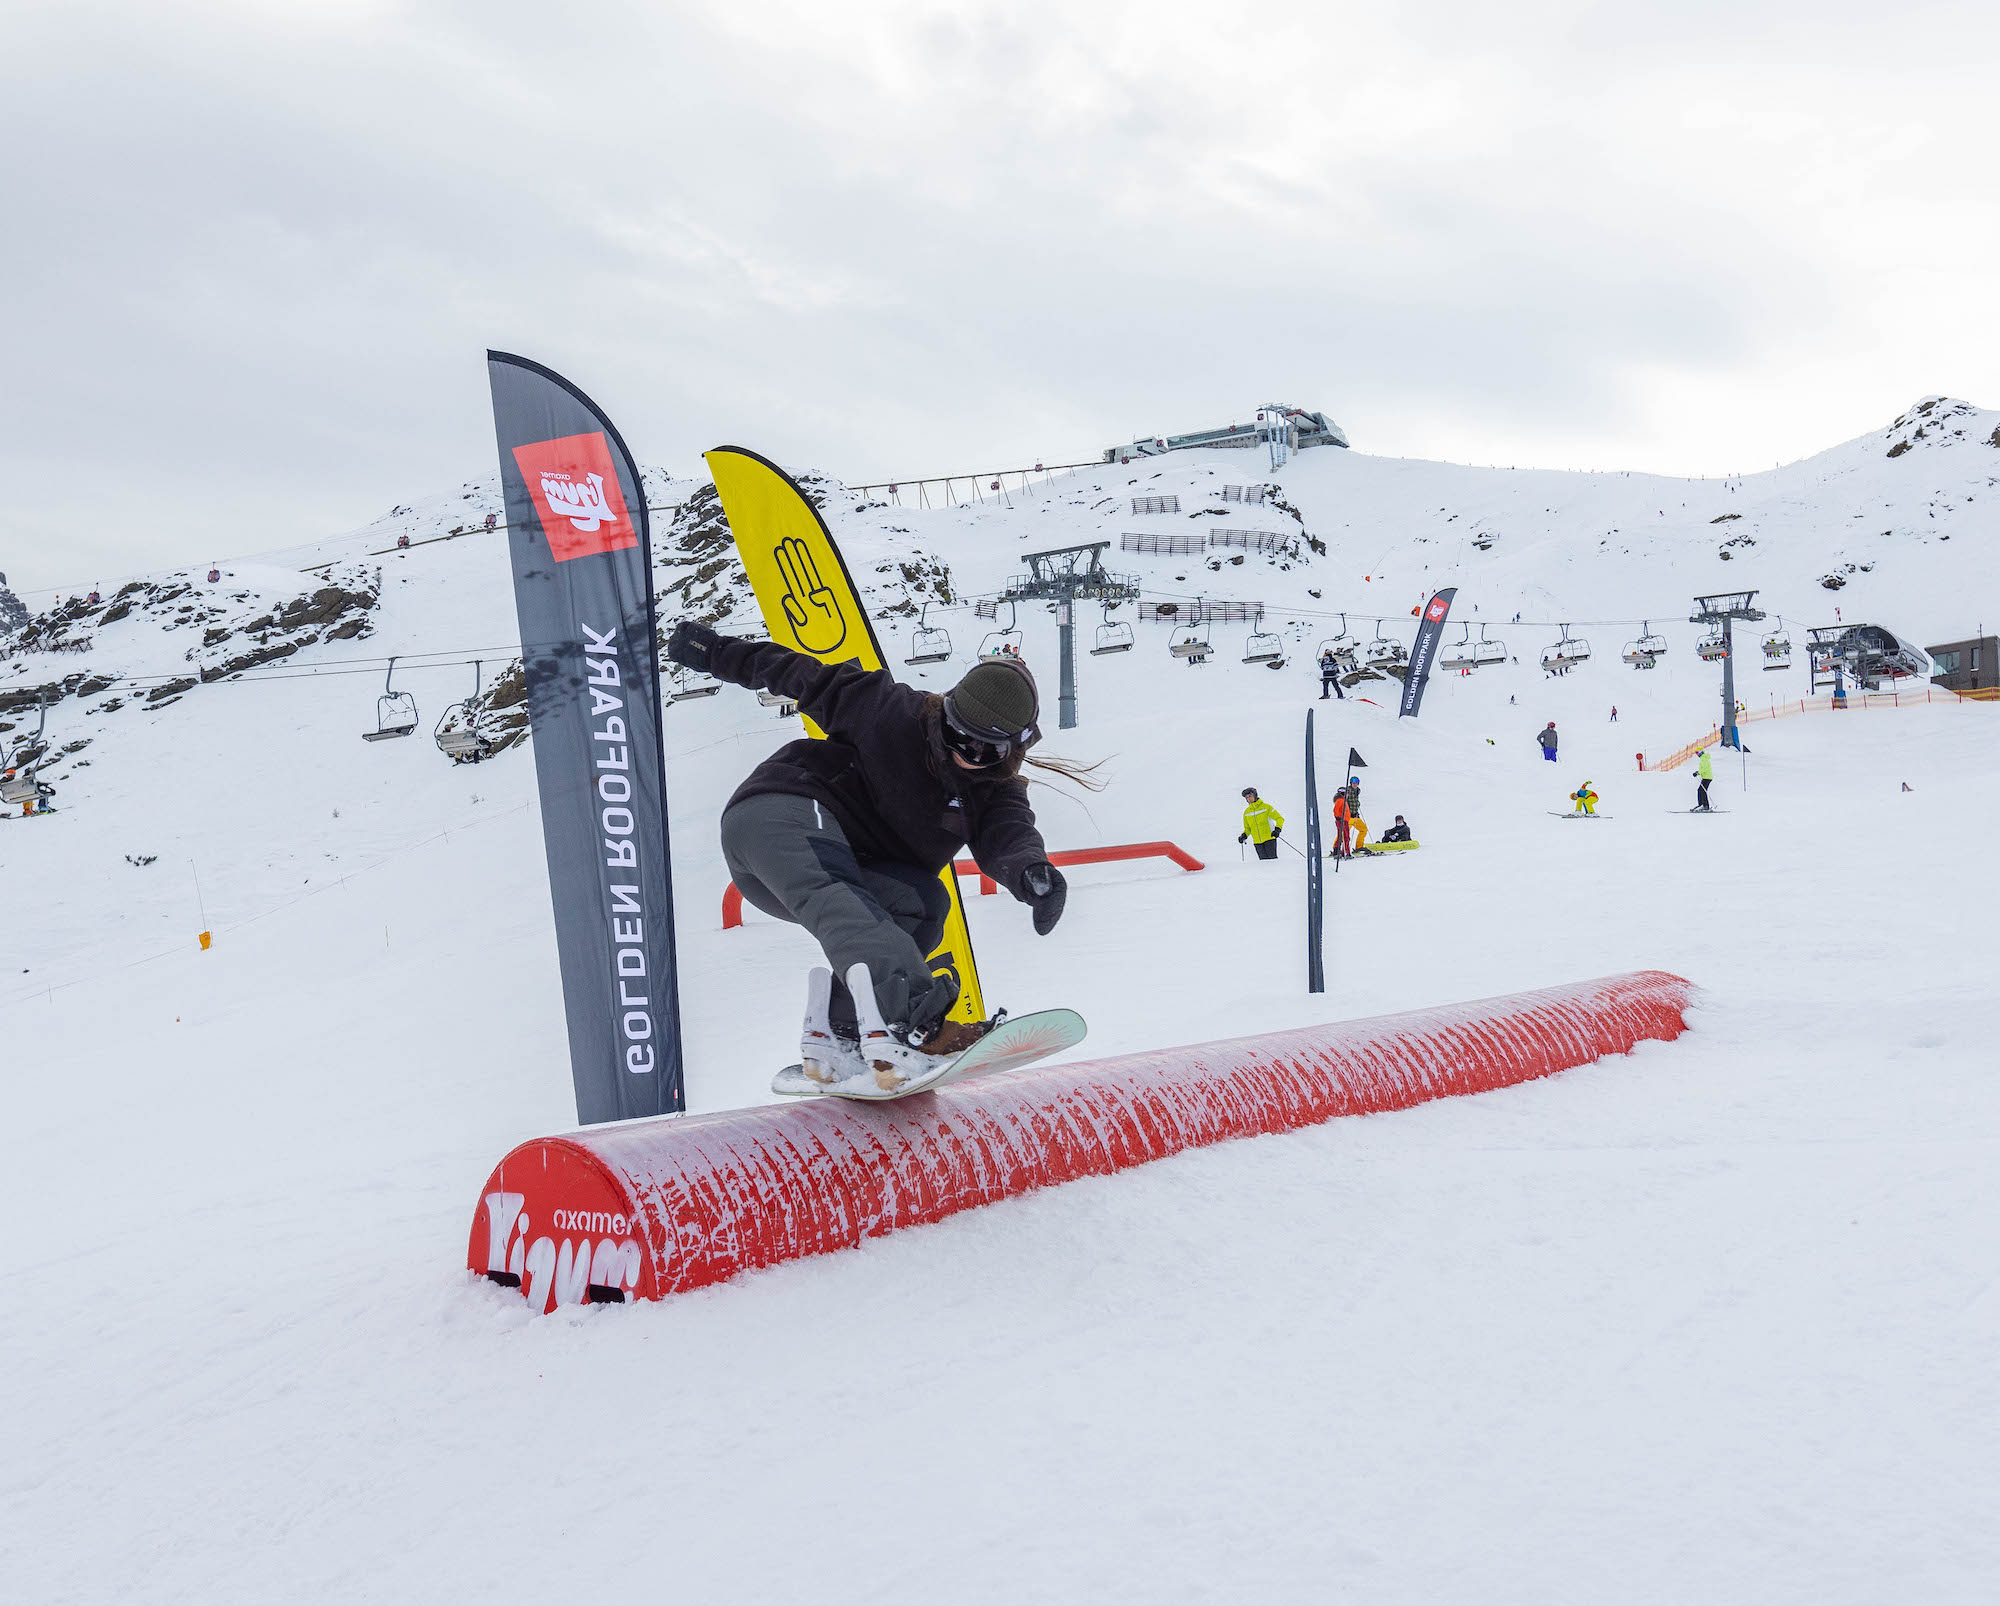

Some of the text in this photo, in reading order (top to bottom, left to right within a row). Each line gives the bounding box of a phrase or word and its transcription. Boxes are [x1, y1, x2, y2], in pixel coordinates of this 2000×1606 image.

[1405, 632, 1433, 710] GOLDEN ROOFPARK
[964, 992, 973, 1016] TM
